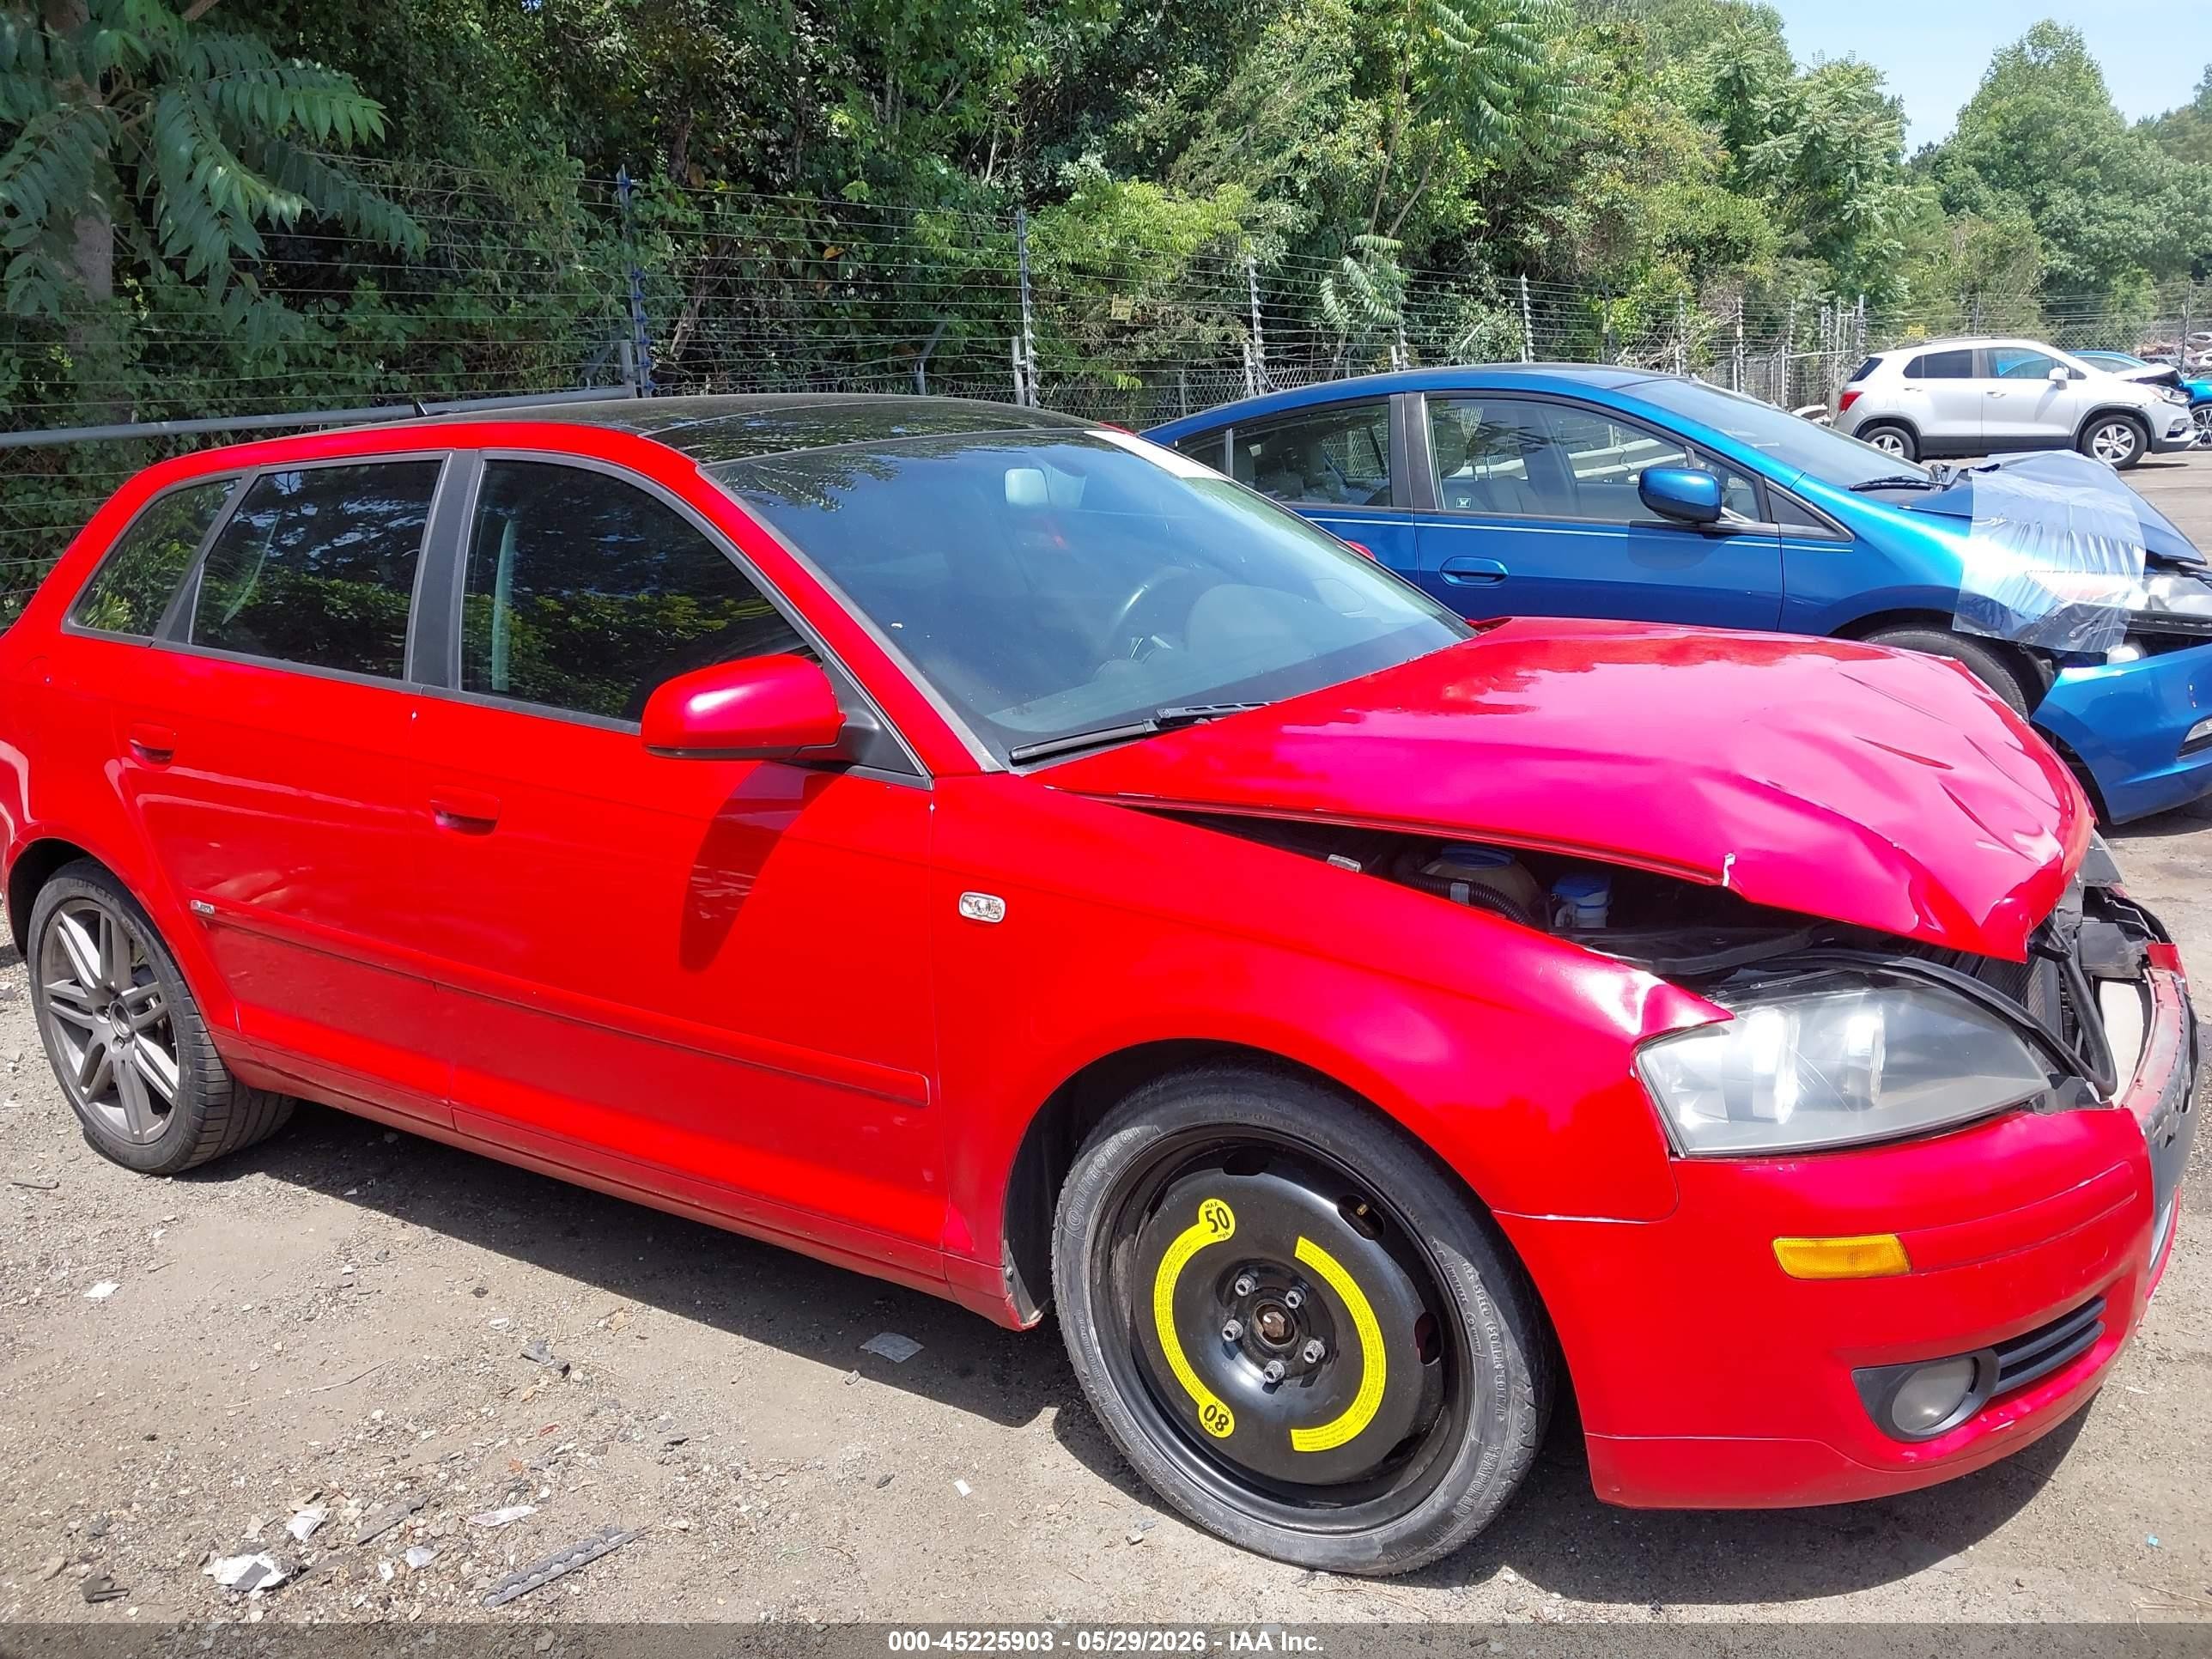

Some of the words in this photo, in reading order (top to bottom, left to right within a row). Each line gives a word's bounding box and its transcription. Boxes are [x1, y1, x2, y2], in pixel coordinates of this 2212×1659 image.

[1066, 1126, 1140, 1231] Continental
[1205, 1206, 1231, 1233] 50
[1474, 1285, 1493, 1317] SPEED
[1204, 1404, 1230, 1432] 80
[1204, 1421, 1218, 1435] MAX
[1452, 1444, 1501, 1522] TEMPORARY
